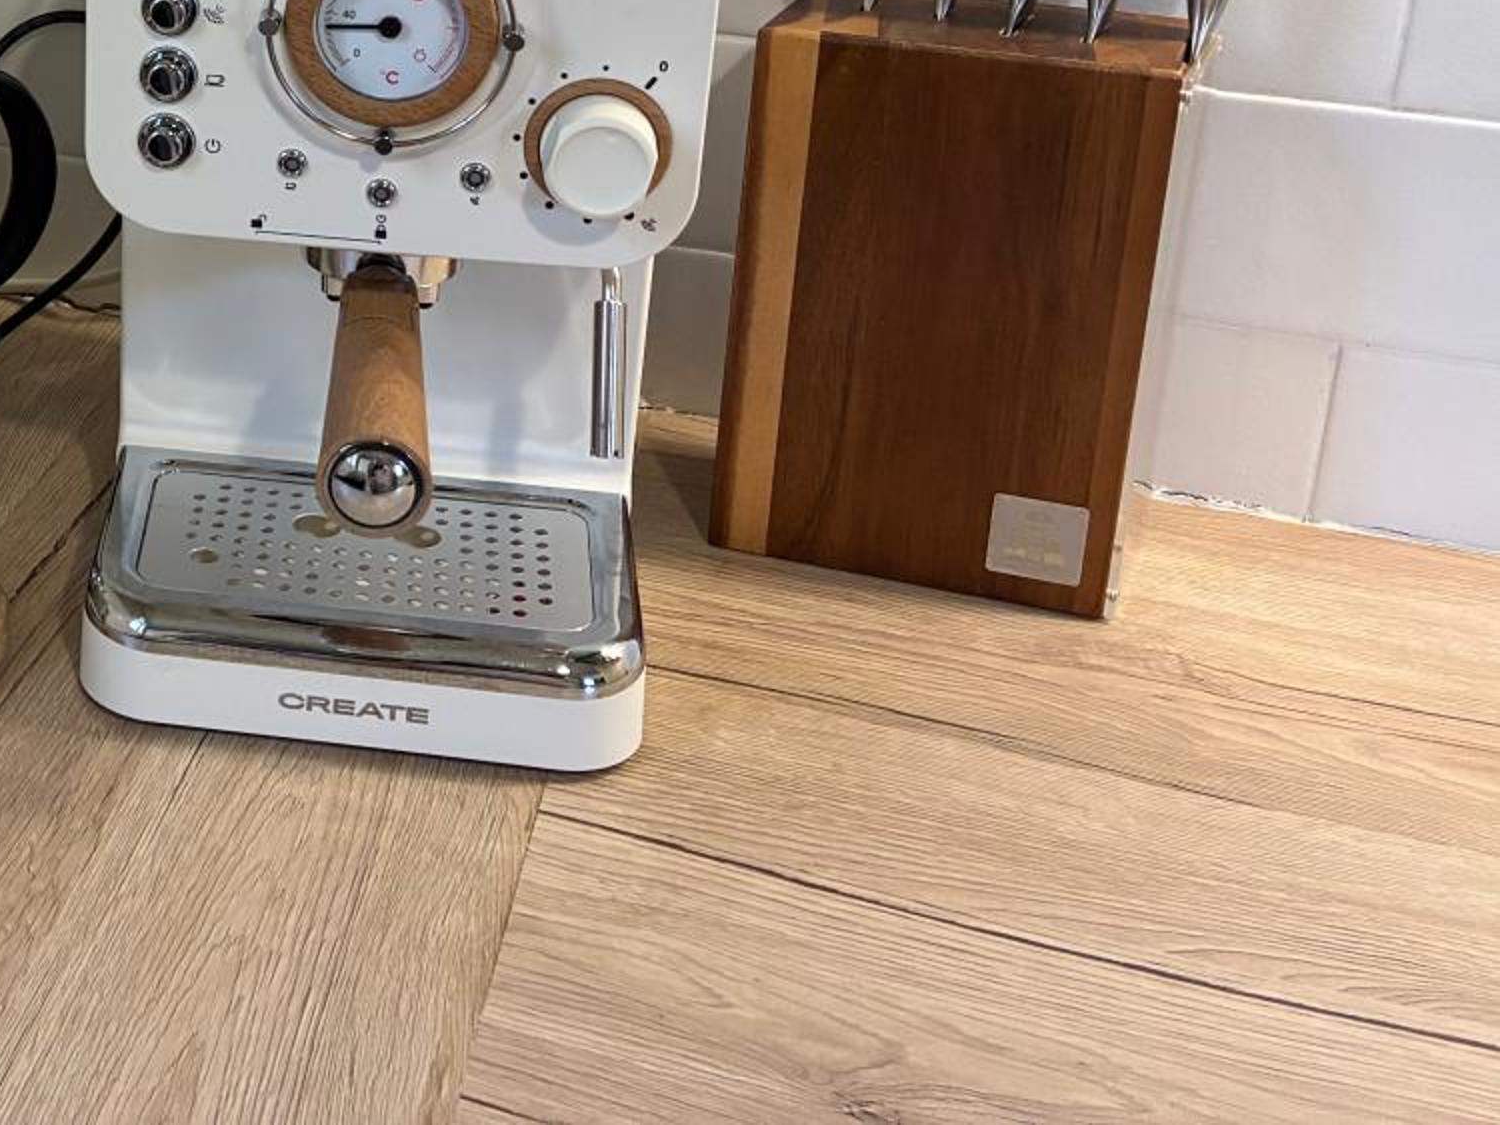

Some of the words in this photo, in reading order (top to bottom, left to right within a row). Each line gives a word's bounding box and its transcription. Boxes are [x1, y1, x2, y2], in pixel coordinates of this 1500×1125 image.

[342, 10, 357, 20] 40
[659, 60, 669, 72] 0
[278, 692, 429, 725] CREATE
